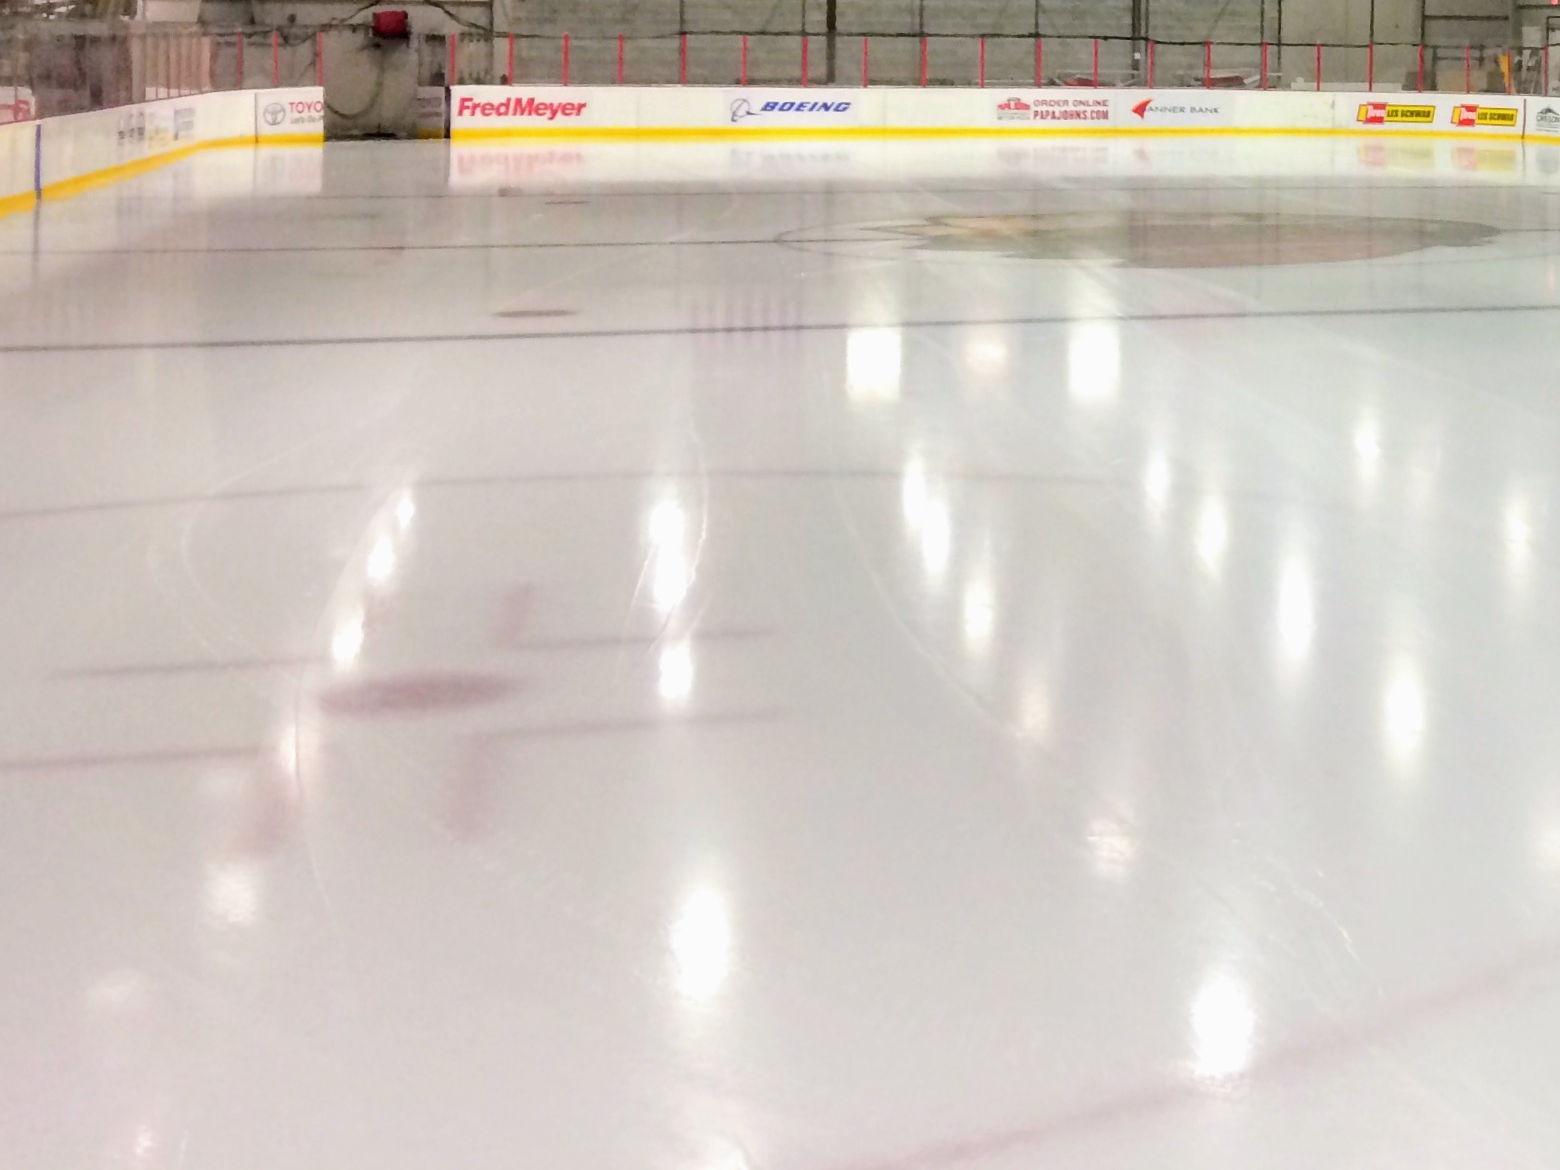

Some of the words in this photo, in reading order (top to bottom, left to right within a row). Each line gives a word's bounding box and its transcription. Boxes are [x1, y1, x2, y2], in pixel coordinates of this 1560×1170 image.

[760, 101, 852, 112] BOEING
[1033, 99, 1069, 107] ORDER
[1072, 99, 1109, 107] ONLINE
[1189, 106, 1219, 114] BANK
[1033, 110, 1109, 120] PAPAJOHNS.COM
